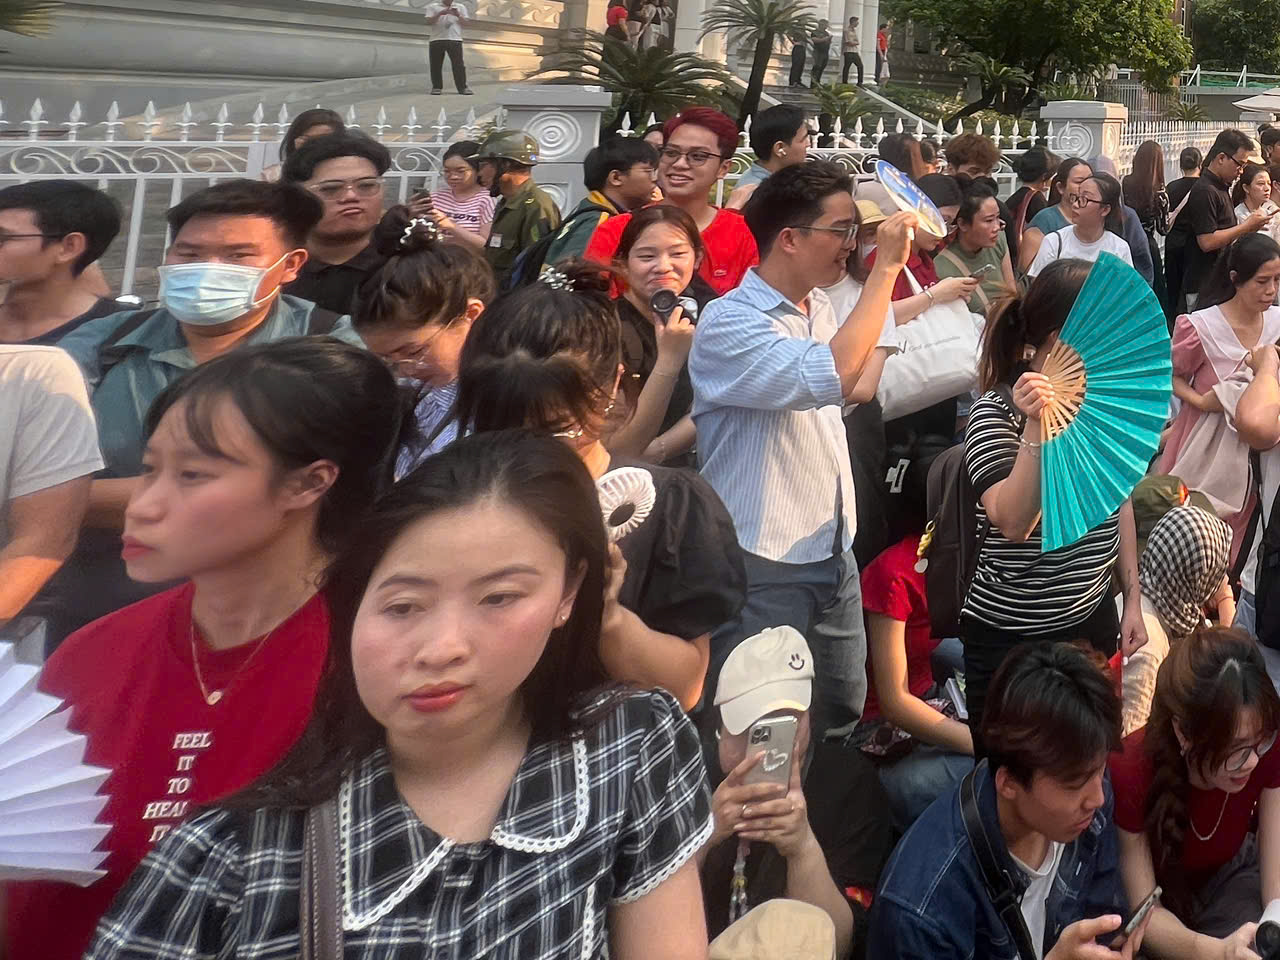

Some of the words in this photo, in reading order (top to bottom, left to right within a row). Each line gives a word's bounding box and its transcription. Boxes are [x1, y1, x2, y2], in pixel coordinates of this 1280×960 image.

[172, 731, 213, 749] FEEL
[176, 755, 197, 772] IT
[167, 777, 190, 794] TO
[148, 824, 171, 842] IT
